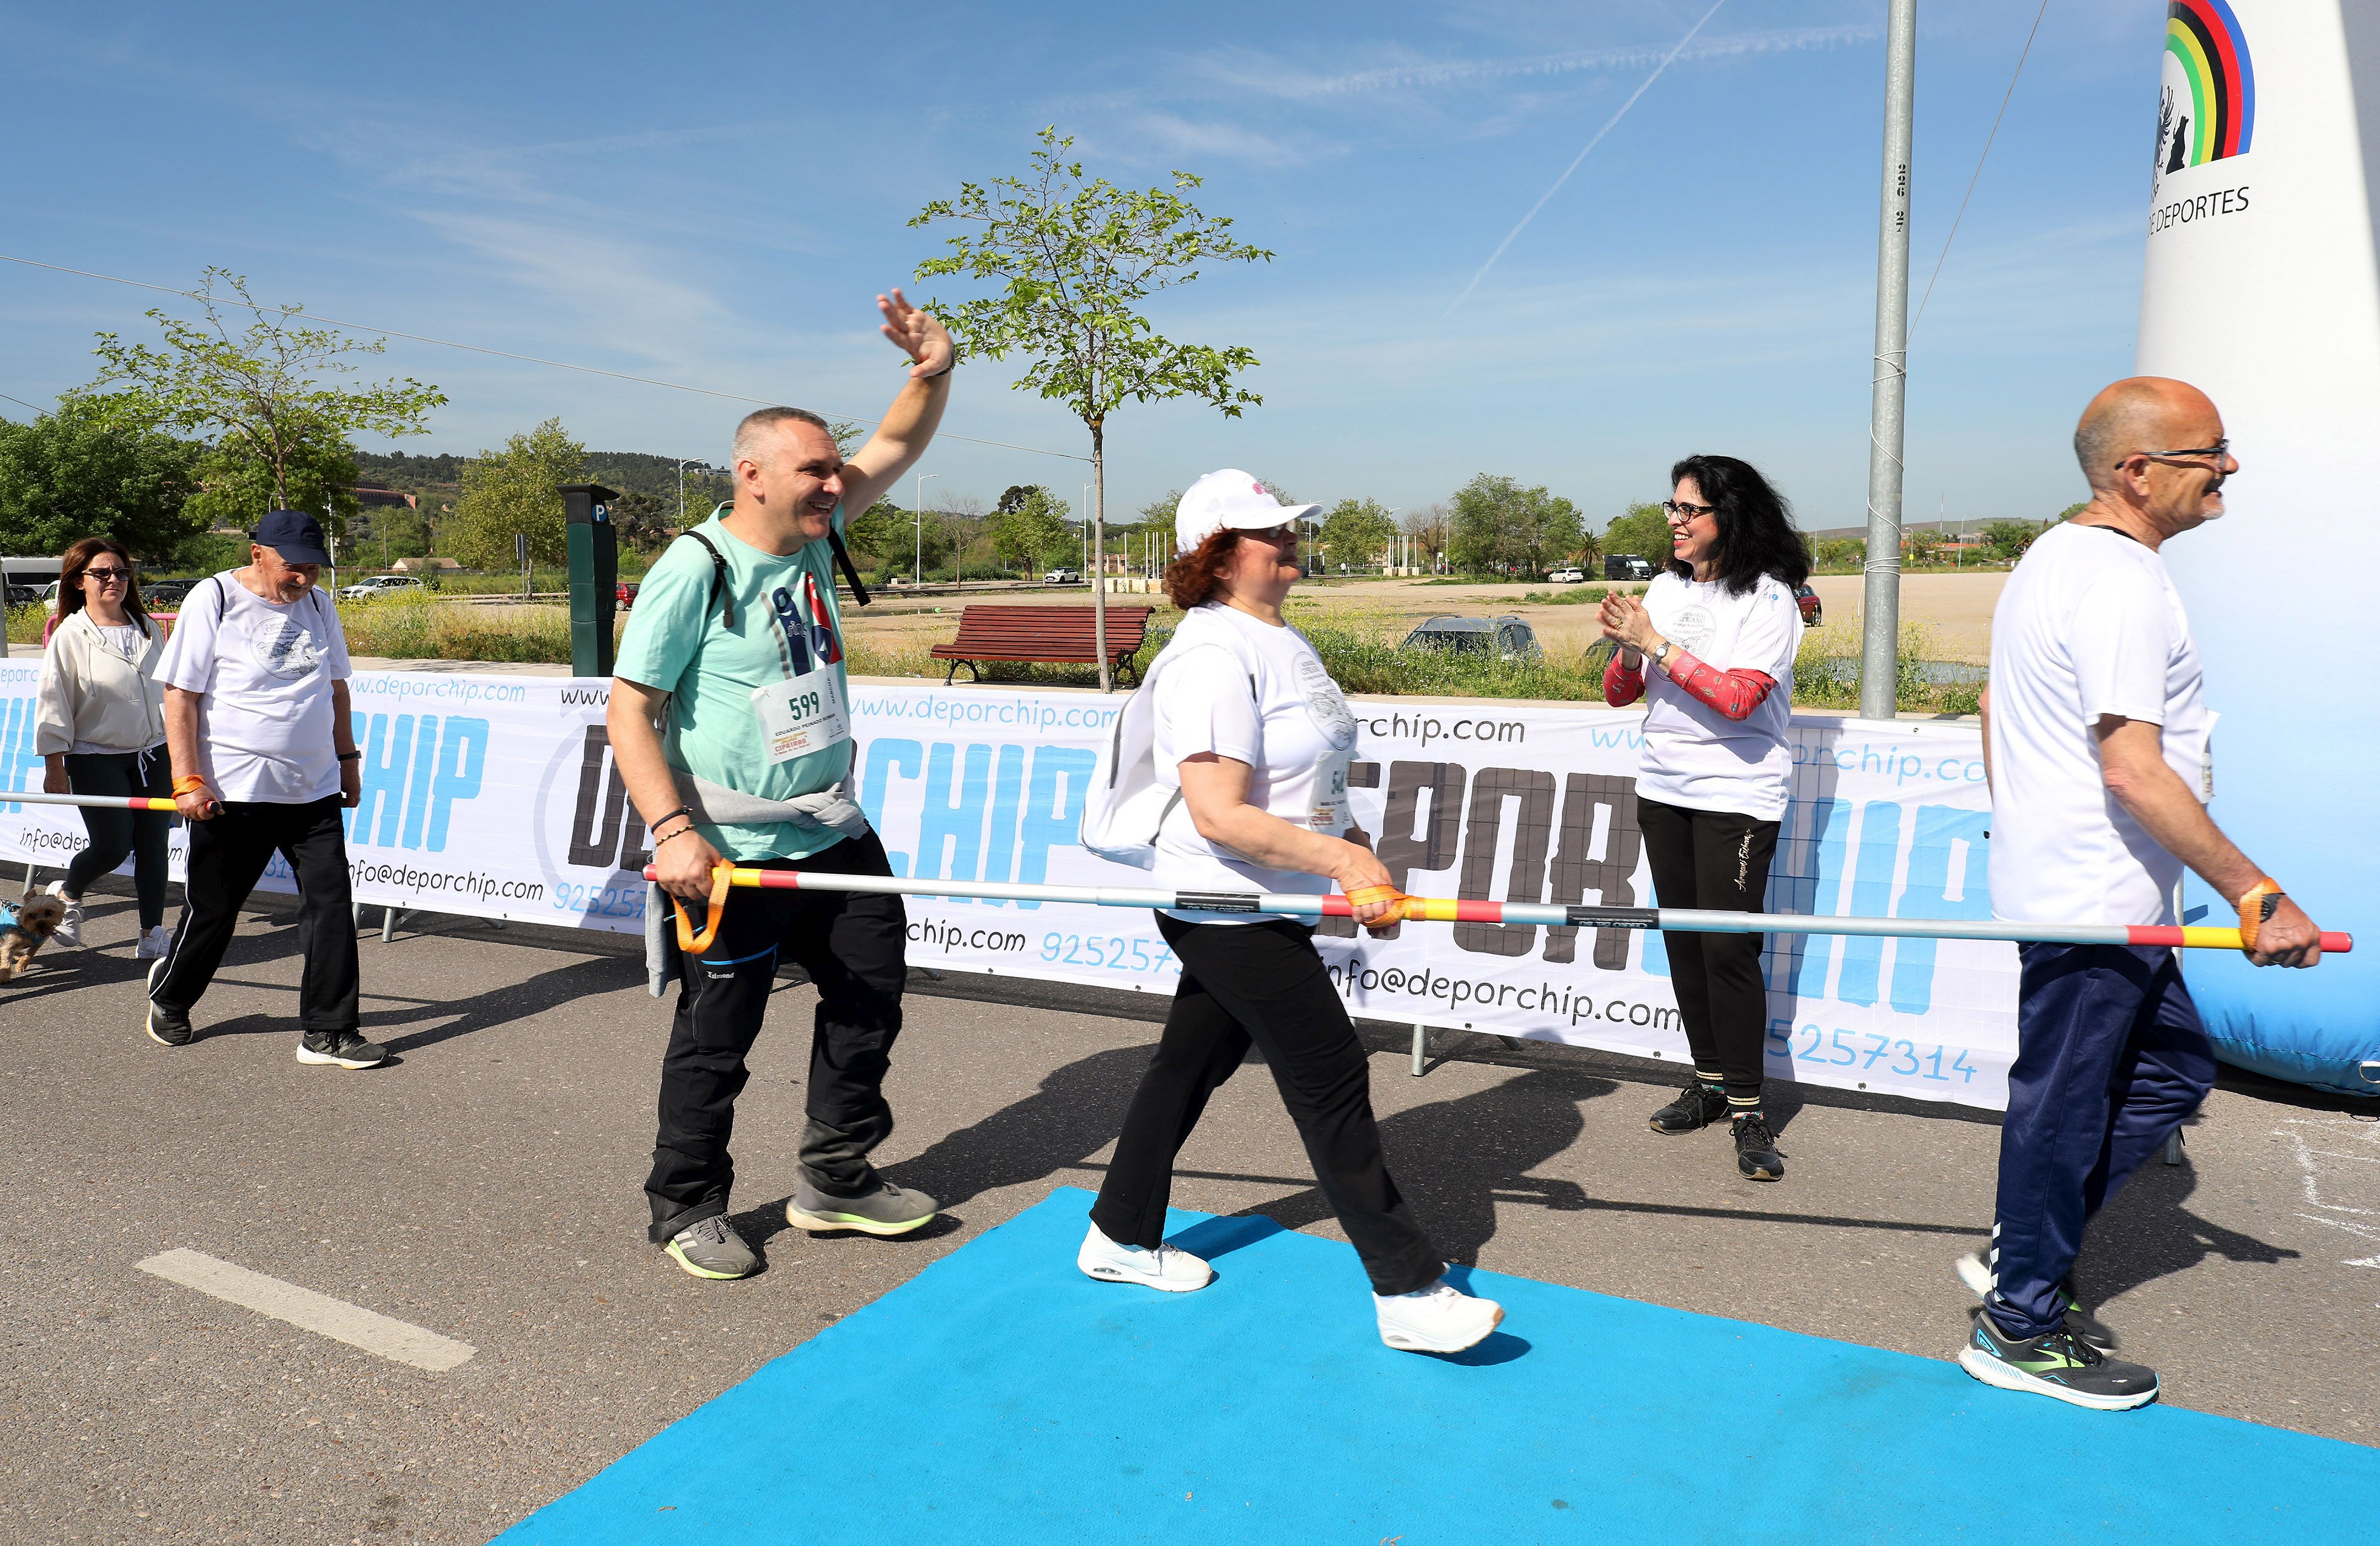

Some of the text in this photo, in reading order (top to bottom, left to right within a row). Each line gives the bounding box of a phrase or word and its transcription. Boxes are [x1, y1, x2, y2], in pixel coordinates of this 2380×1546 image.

[2156, 186, 2249, 233] DEPORTES
[596, 504, 605, 521] P
[346, 675, 526, 705] w.deporchip.com
[789, 691, 819, 721] 599
[775, 725, 801, 736] EDUARDO
[347, 859, 647, 919] nfo@deporchip.com 925257
[1734, 859, 1748, 892] Armani
[1040, 931, 1183, 976] 925257
[1767, 1018, 1977, 1083] 5257314
